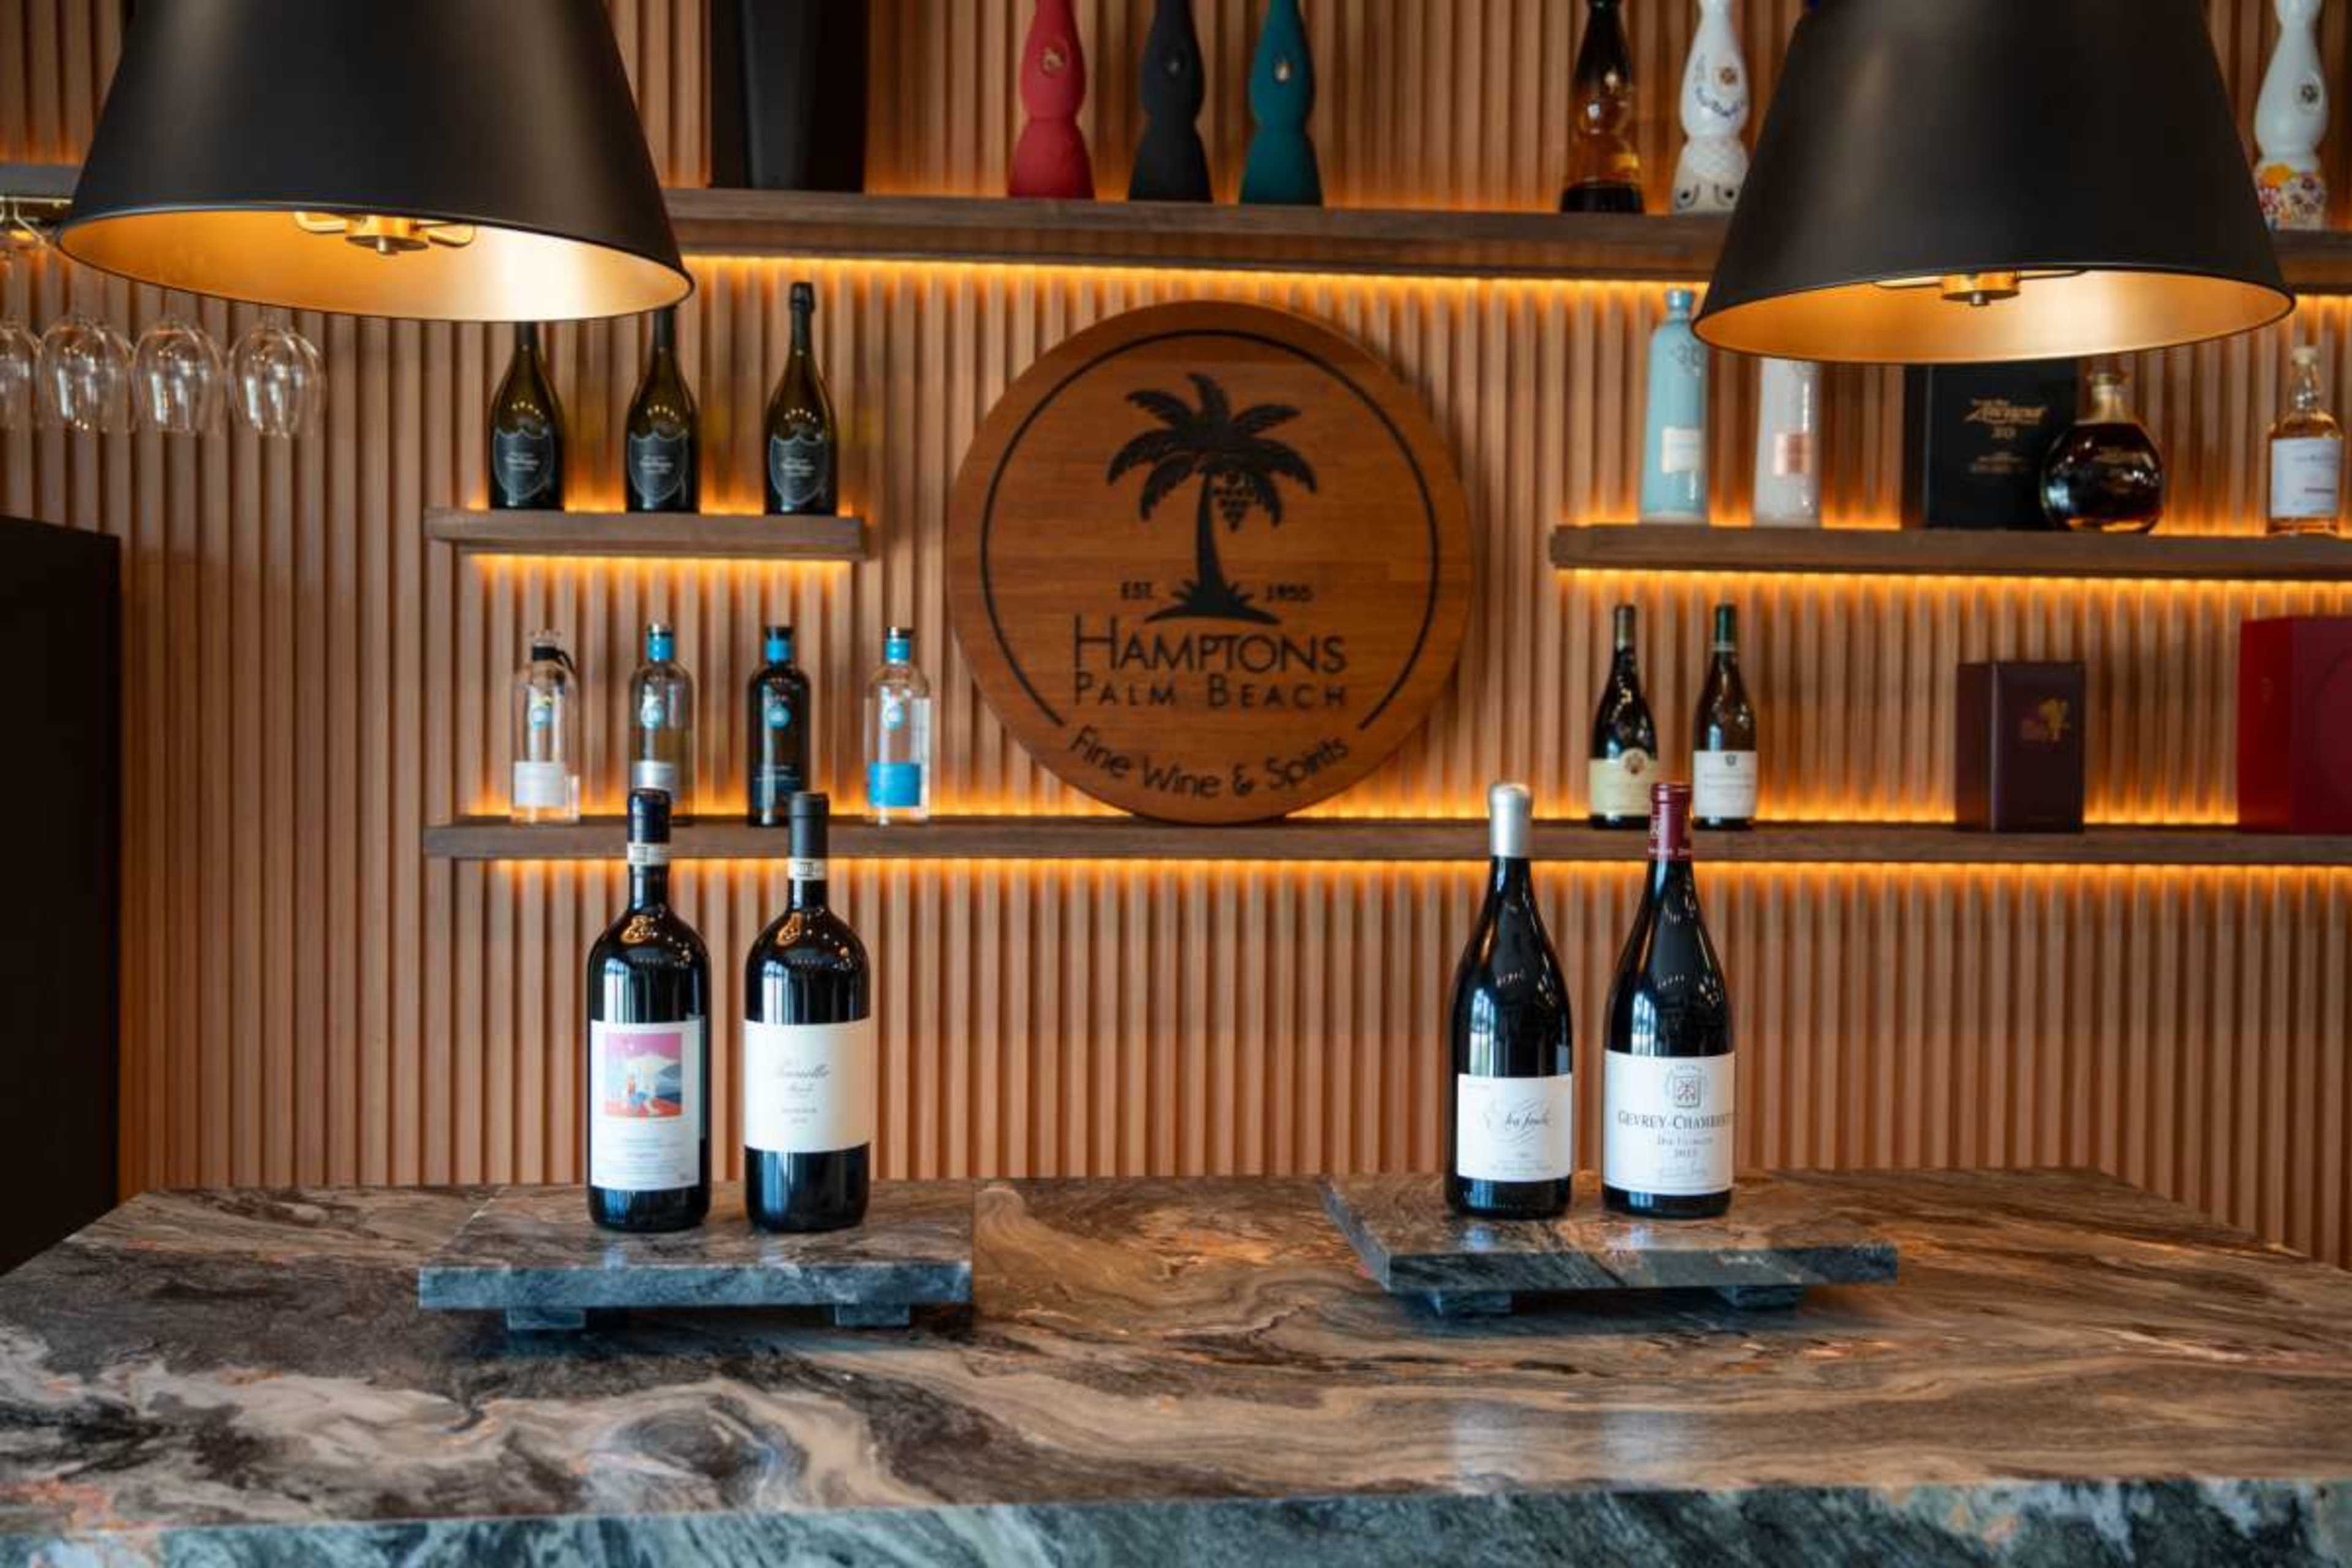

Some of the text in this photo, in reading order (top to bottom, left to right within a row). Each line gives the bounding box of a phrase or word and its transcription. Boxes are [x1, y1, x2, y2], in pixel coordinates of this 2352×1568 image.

[1074, 614, 1346, 673] HAMPTONS
[1074, 672, 1346, 709] PALM BEACH
[1069, 726, 1348, 797] Fine Wine & Spirits
